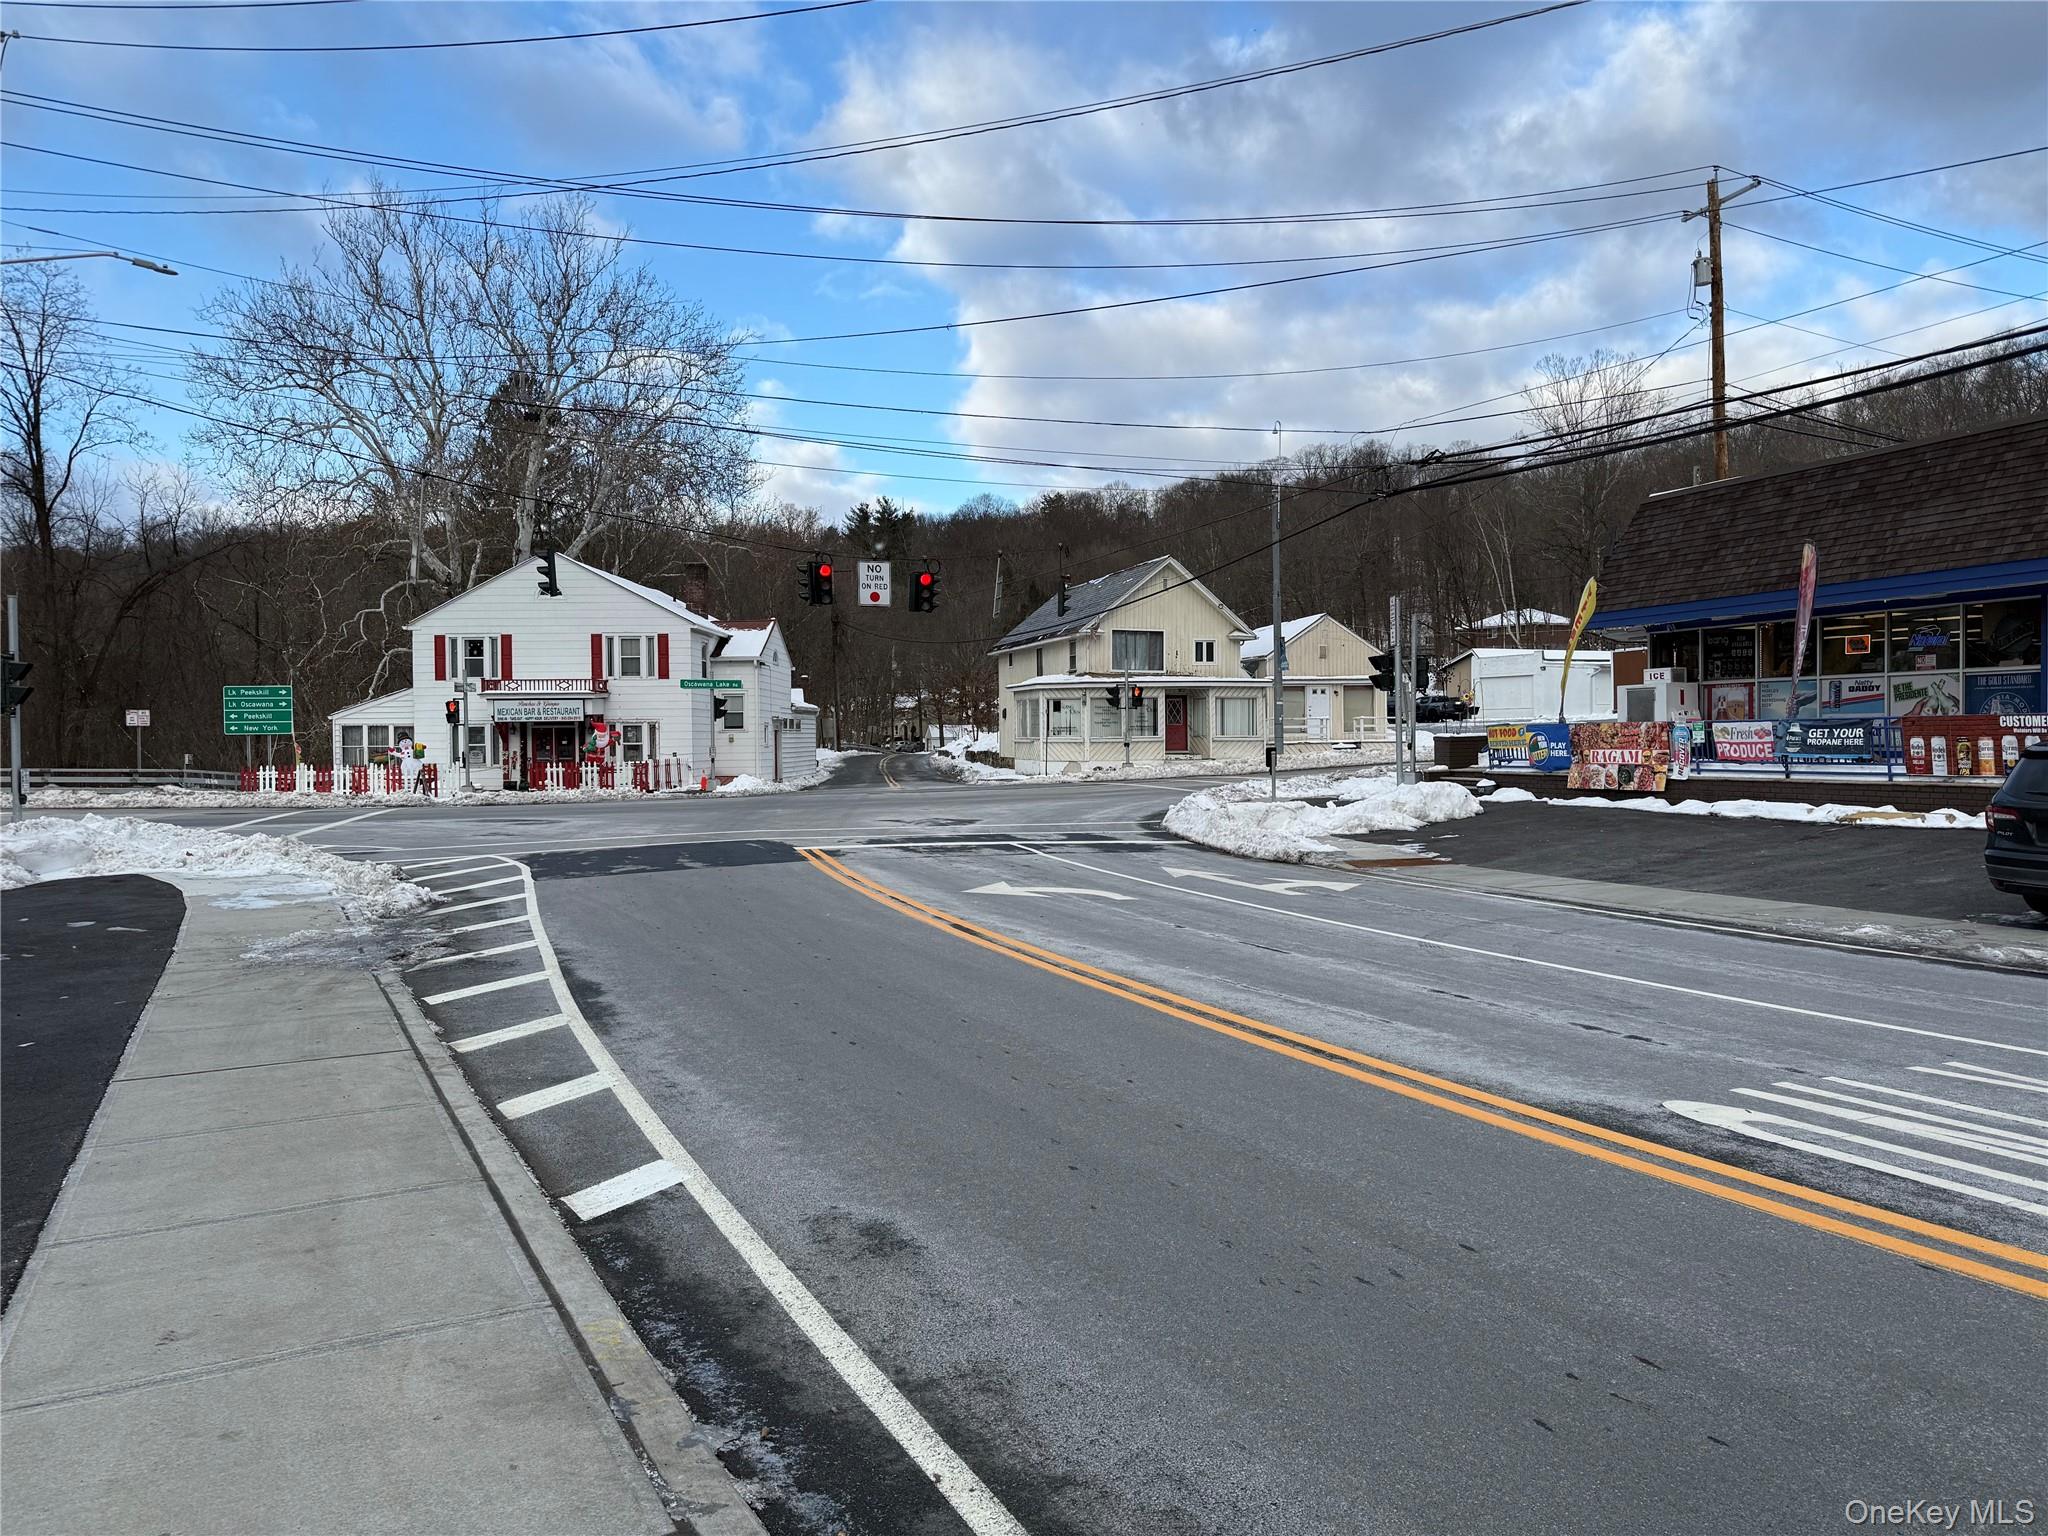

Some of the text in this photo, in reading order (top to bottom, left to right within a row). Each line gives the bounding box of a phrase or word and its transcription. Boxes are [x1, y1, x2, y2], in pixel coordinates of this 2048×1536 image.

[867, 564, 882, 573] NO
[1649, 672, 1665, 680] ICE
[1987, 676, 2002, 686] GOLD
[2002, 675, 2032, 685] STANDARD
[1902, 681, 1912, 691] THE
[497, 707, 581, 716] MEXICAN BAR & RESTAURANT
[2000, 715, 2048, 727] CUSTOME
[1499, 727, 1517, 737] FOOD
[1730, 726, 1753, 740] Fresh
[1808, 728, 1864, 738] GET YOUR
[1807, 738, 1842, 746] PROPANE
[1716, 743, 1774, 758] PRODUCE
[1591, 750, 1640, 763] RAGAM
[1677, 738, 1686, 776] RECOVER
